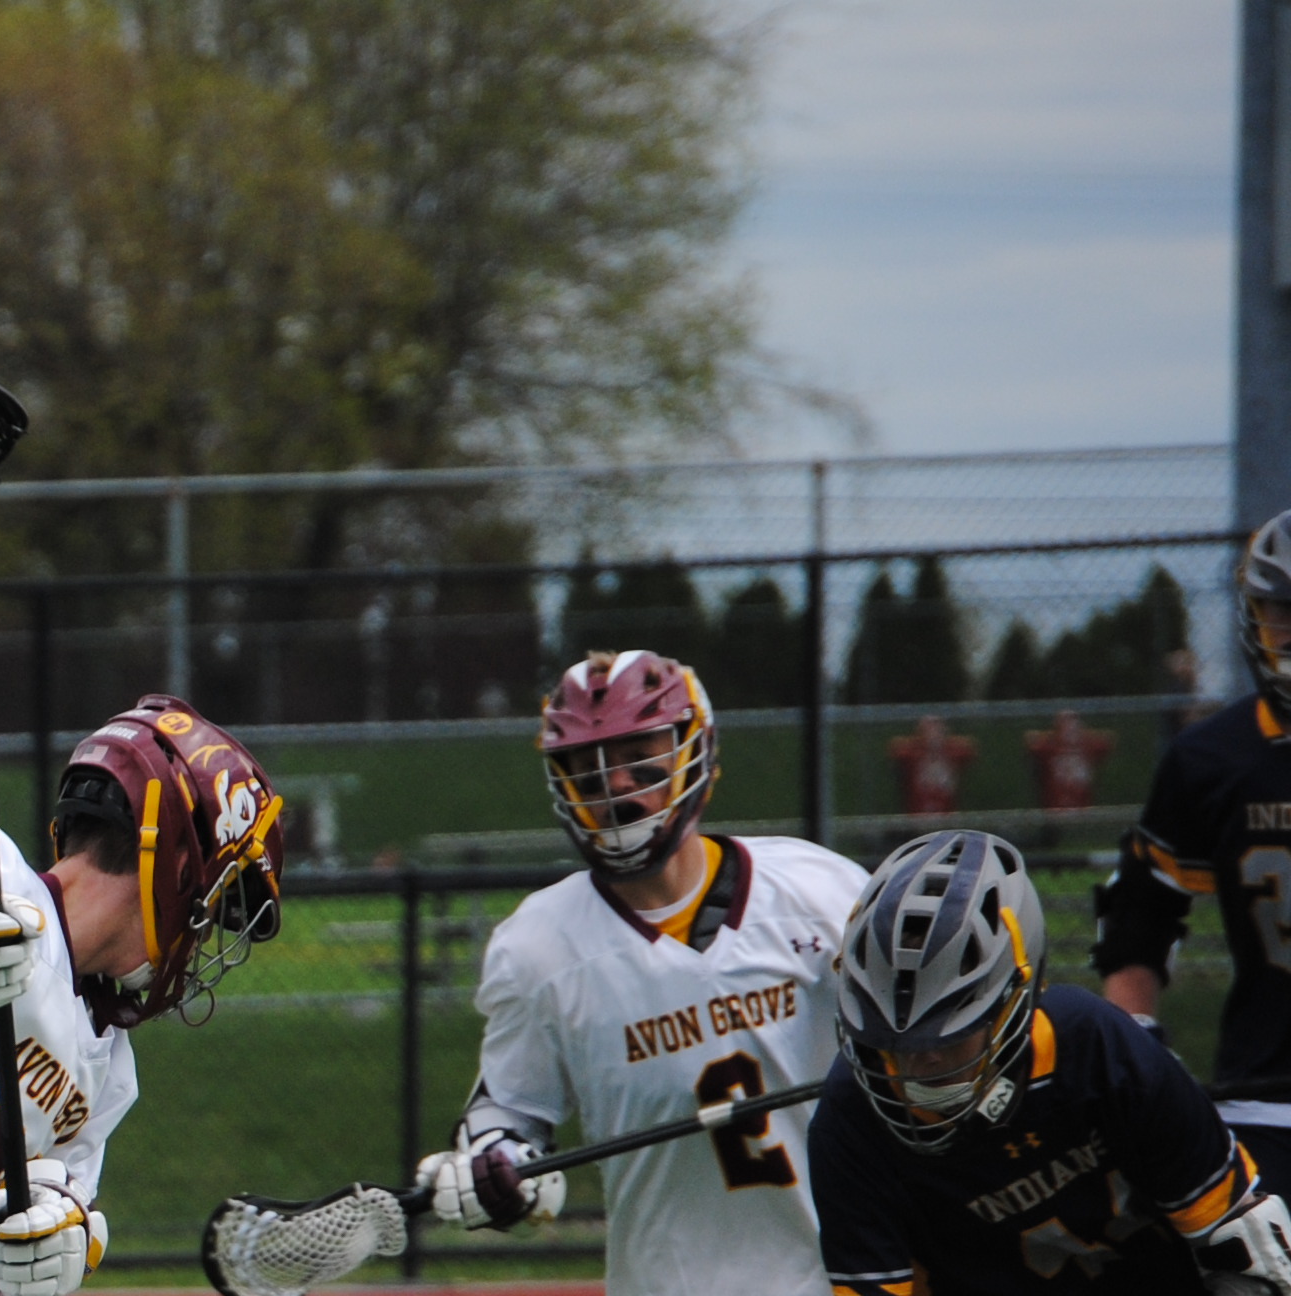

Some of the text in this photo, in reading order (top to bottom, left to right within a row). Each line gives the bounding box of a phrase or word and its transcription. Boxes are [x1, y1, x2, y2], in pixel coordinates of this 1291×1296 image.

[624, 979, 797, 1062] AVON GROVE
[695, 1049, 798, 1192] 2
